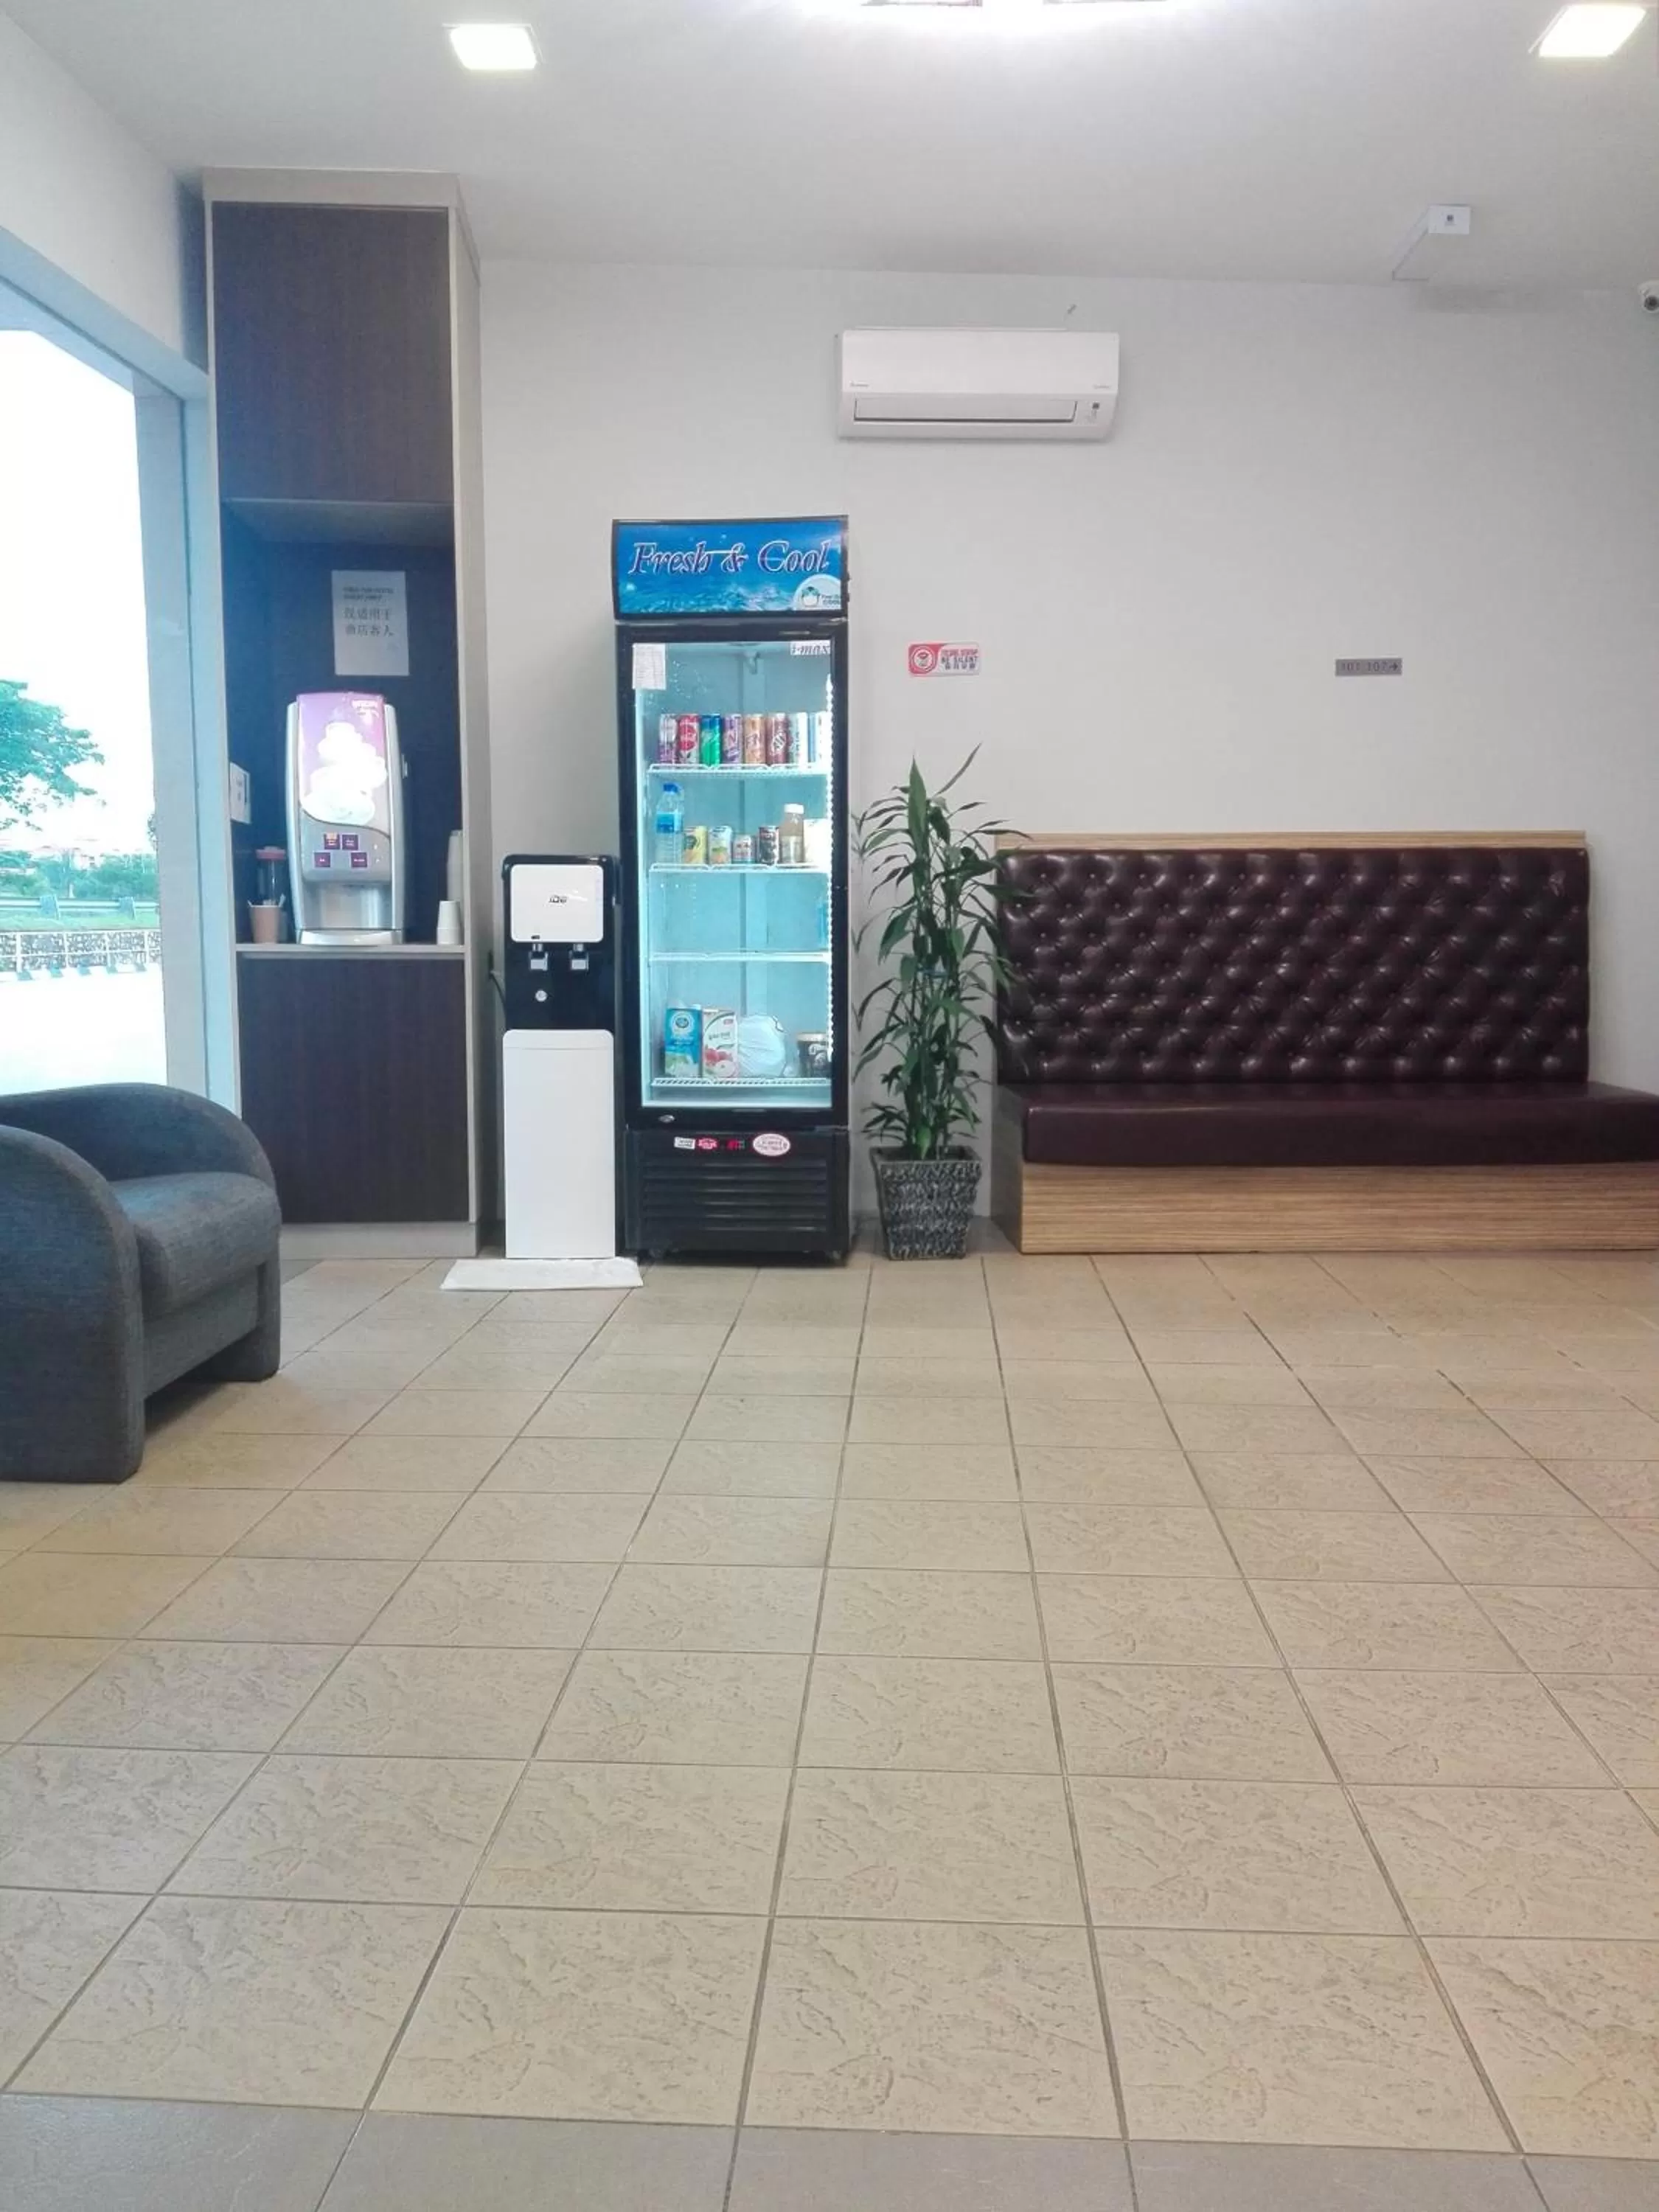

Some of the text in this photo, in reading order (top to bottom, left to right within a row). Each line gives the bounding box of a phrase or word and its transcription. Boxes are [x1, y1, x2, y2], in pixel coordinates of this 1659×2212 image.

[627, 539, 832, 575] Fresh & Cool
